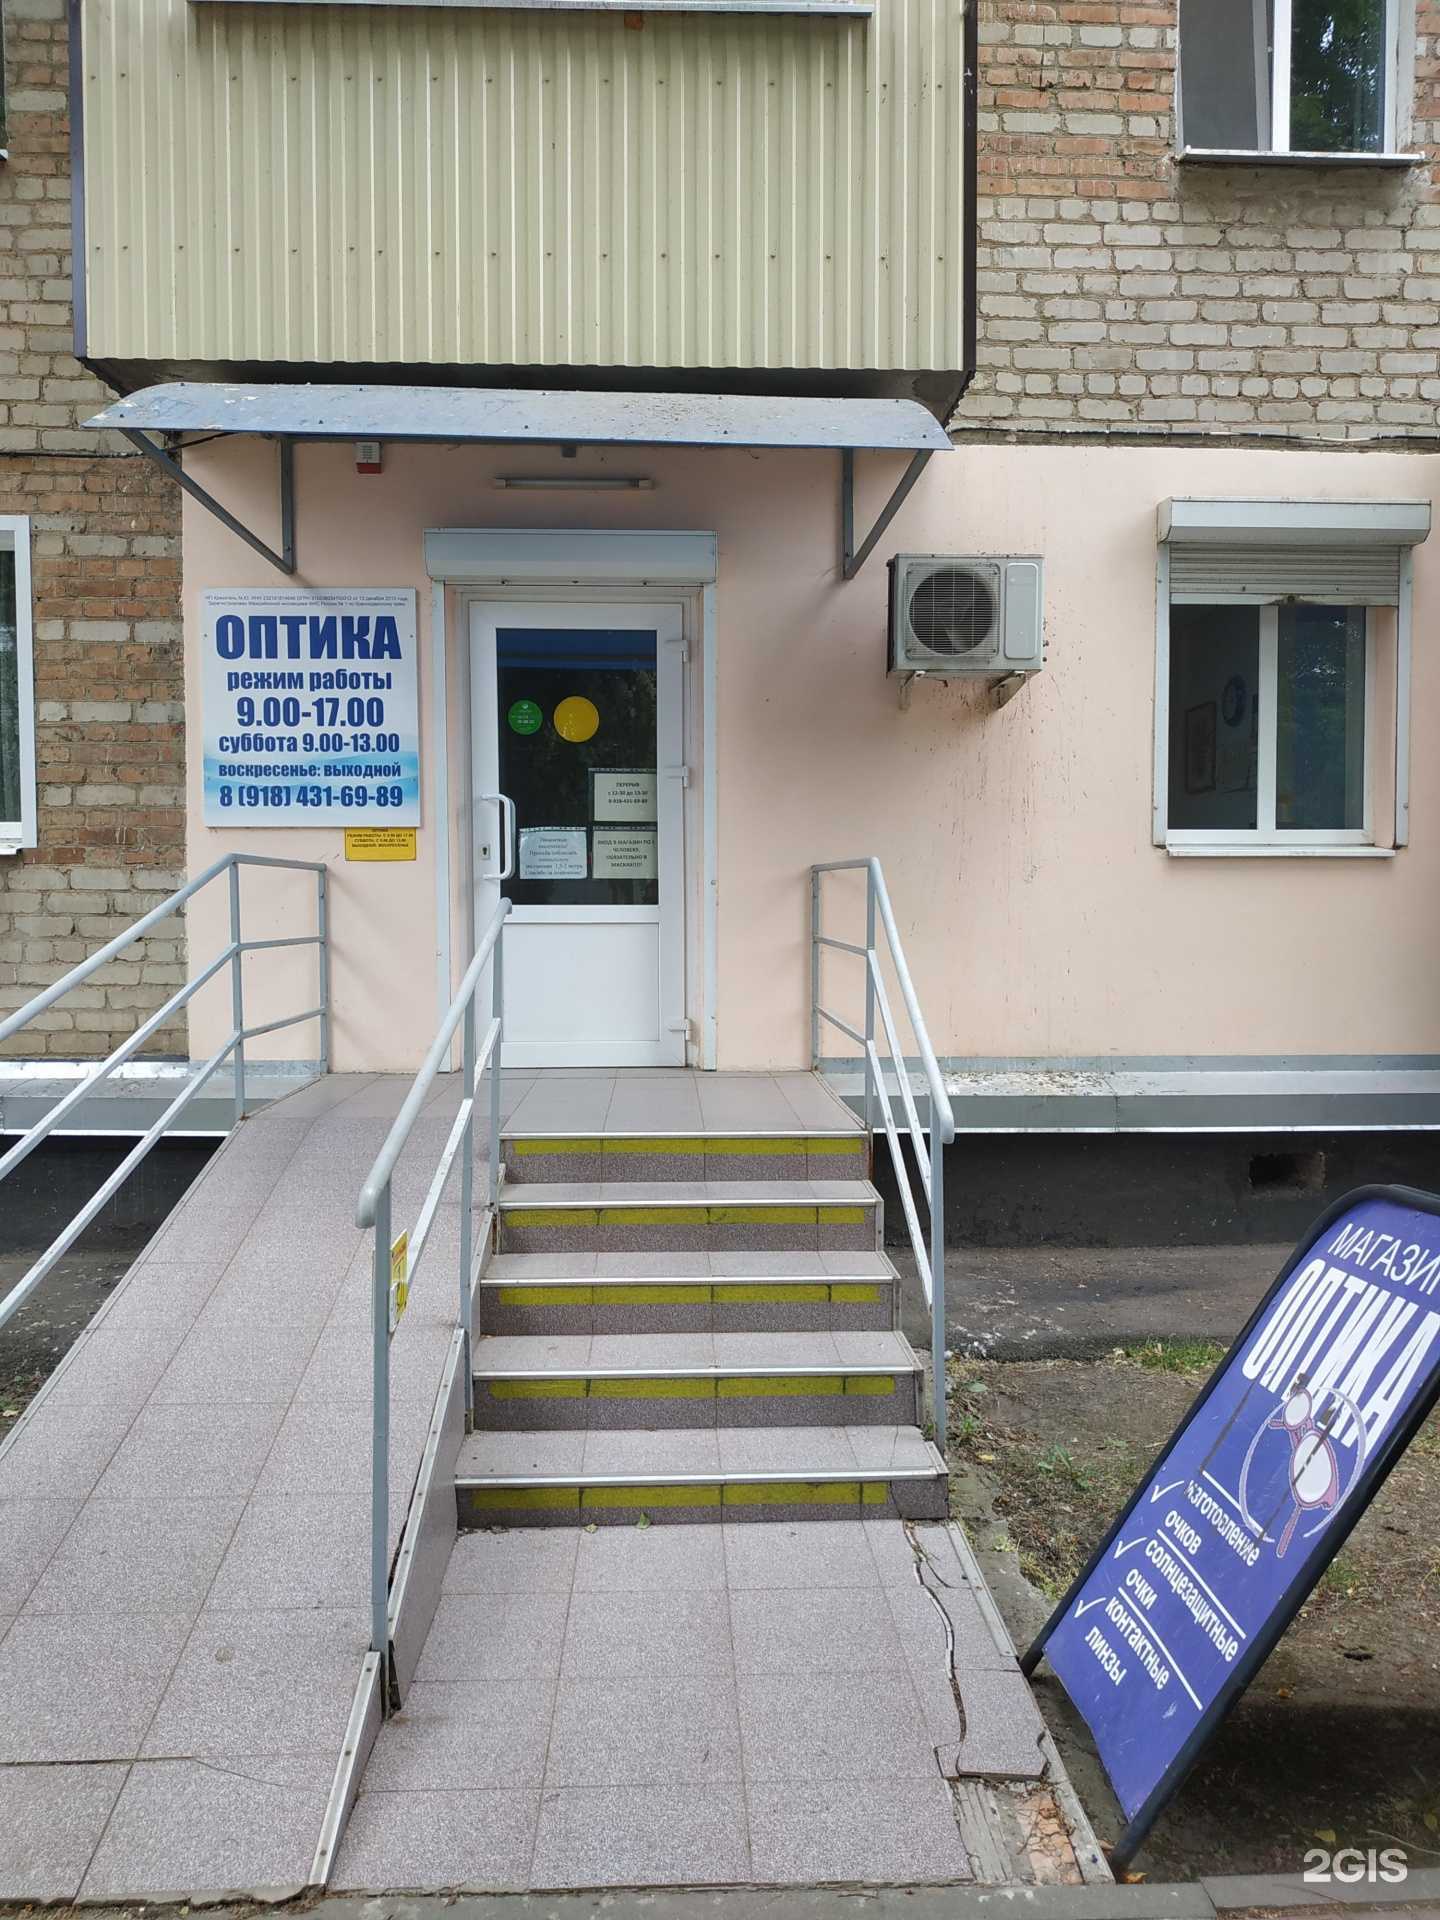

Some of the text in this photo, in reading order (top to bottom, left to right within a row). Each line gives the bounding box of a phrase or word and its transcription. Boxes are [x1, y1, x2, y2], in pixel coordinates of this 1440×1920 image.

[216, 615, 402, 660] ОПТИКА
[227, 669, 392, 691] режим работы
[237, 697, 384, 727] 9.00-17.00
[219, 733, 400, 753] суббота 9.00-13.00
[218, 761, 401, 779] воскресенье: выходной
[219, 785, 403, 807] 8 (918) 431-69-89
[1242, 1258, 1440, 1453] ОПТИКА
[1164, 1510, 1202, 1555] очков
[1184, 1480, 1260, 1567] изготовление
[1125, 1568, 1158, 1610] очки
[1145, 1539, 1239, 1662] солнцезащитные
[1084, 1625, 1127, 1686] линзы
[1105, 1596, 1169, 1690] контактные
